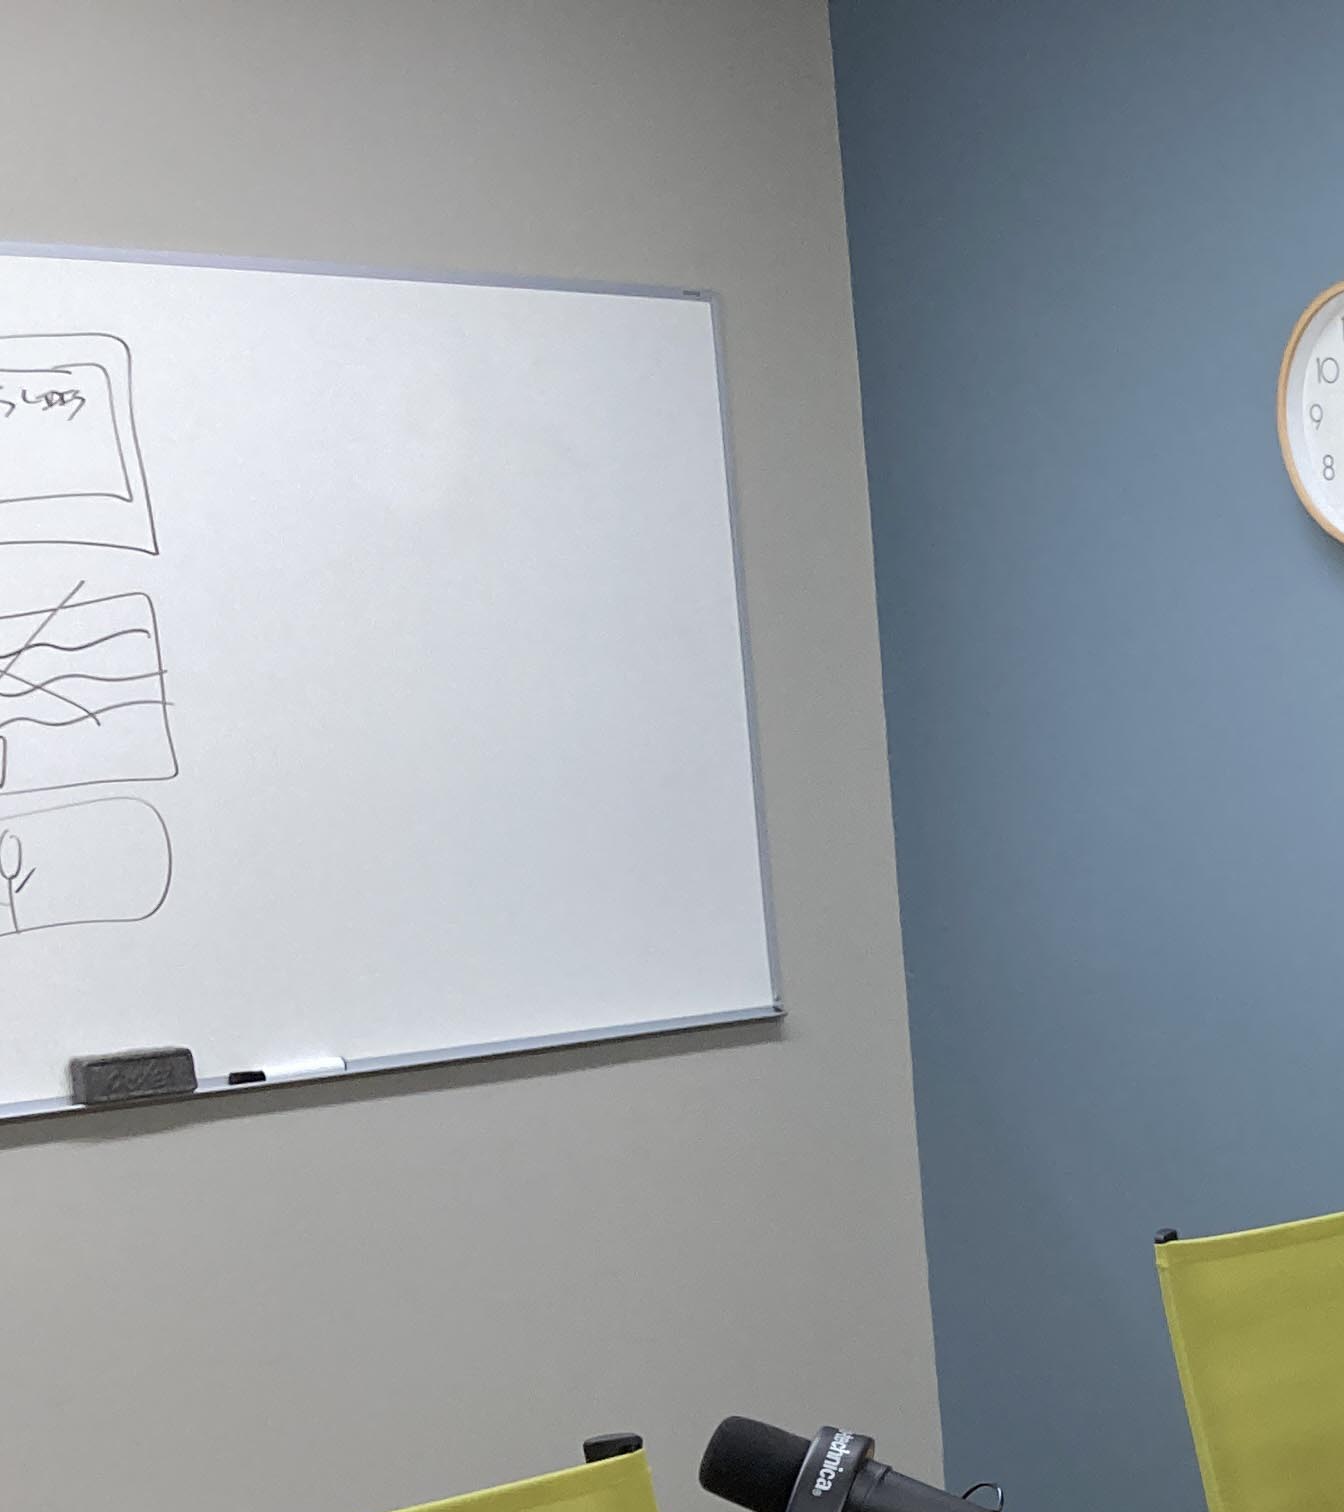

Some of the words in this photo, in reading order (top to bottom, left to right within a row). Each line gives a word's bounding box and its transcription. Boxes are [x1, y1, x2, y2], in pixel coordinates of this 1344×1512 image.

[1316, 357, 1339, 384] 10
[1310, 404, 1323, 430] 9
[1323, 454, 1335, 480] 8
